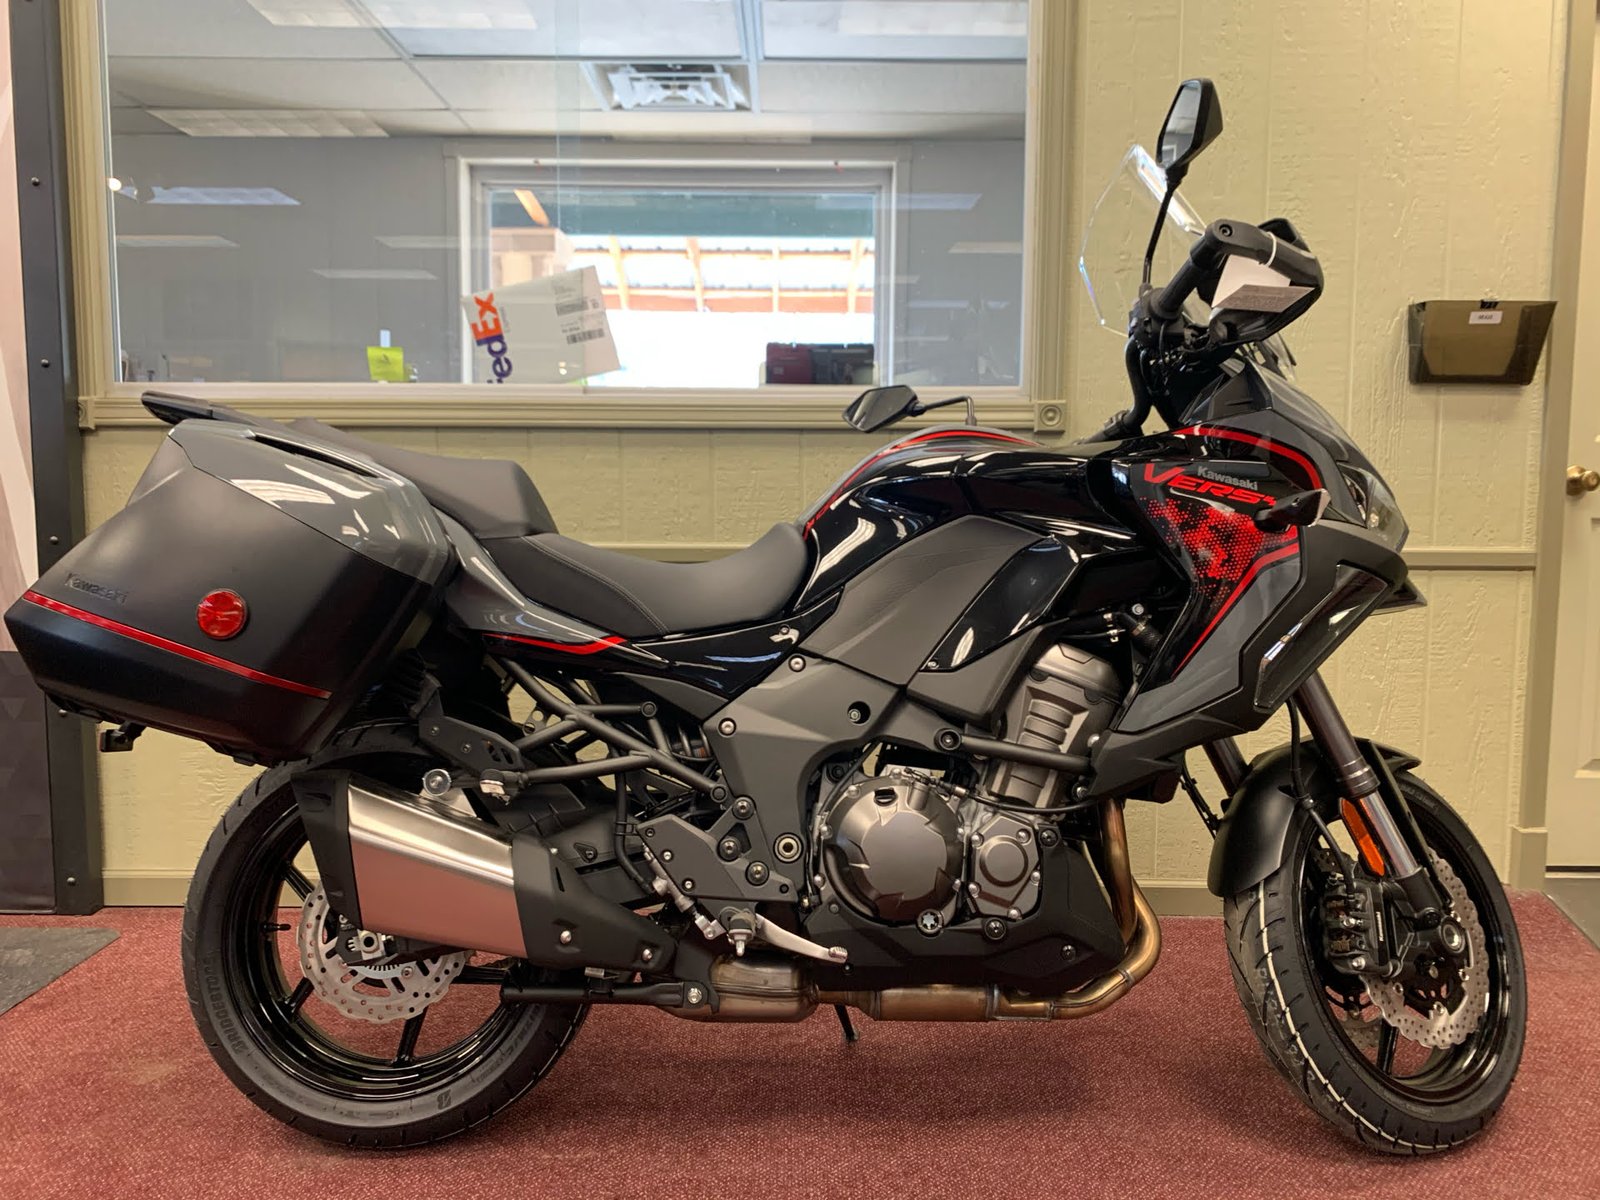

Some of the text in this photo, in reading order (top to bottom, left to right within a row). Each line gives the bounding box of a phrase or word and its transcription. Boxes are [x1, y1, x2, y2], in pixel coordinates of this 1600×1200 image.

[471, 293, 512, 383] edEx
[1197, 466, 1258, 491] Kawasaki
[65, 573, 129, 604] Kawasaki
